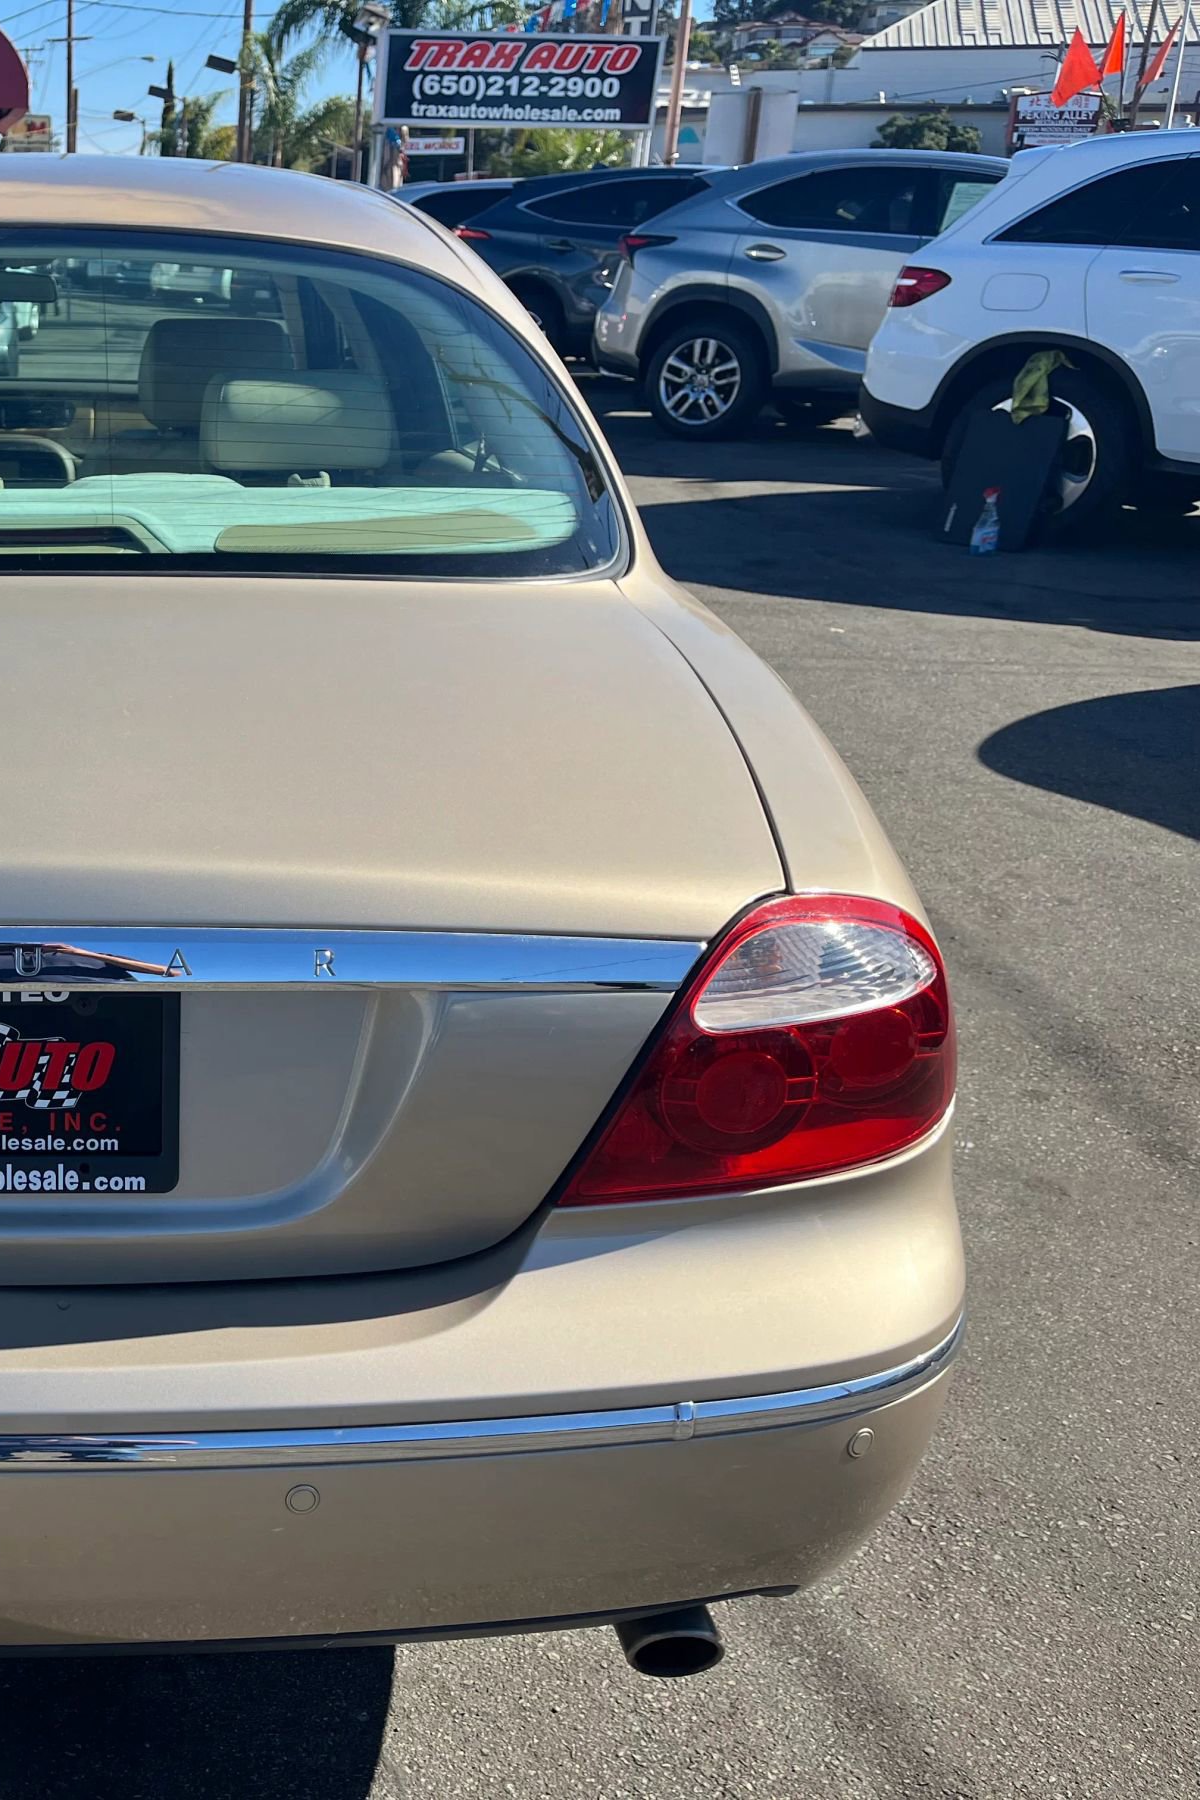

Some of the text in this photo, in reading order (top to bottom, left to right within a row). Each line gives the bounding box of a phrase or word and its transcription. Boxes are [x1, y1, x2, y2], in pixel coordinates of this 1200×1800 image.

[404, 39, 642, 75] TRAX AUTO
[412, 74, 621, 101] (650)212-2900
[410, 101, 621, 121] traxautowholesale.com
[1019, 111, 1095, 120] PEKING ALLEY
[49, 1112, 122, 1132] INC.
